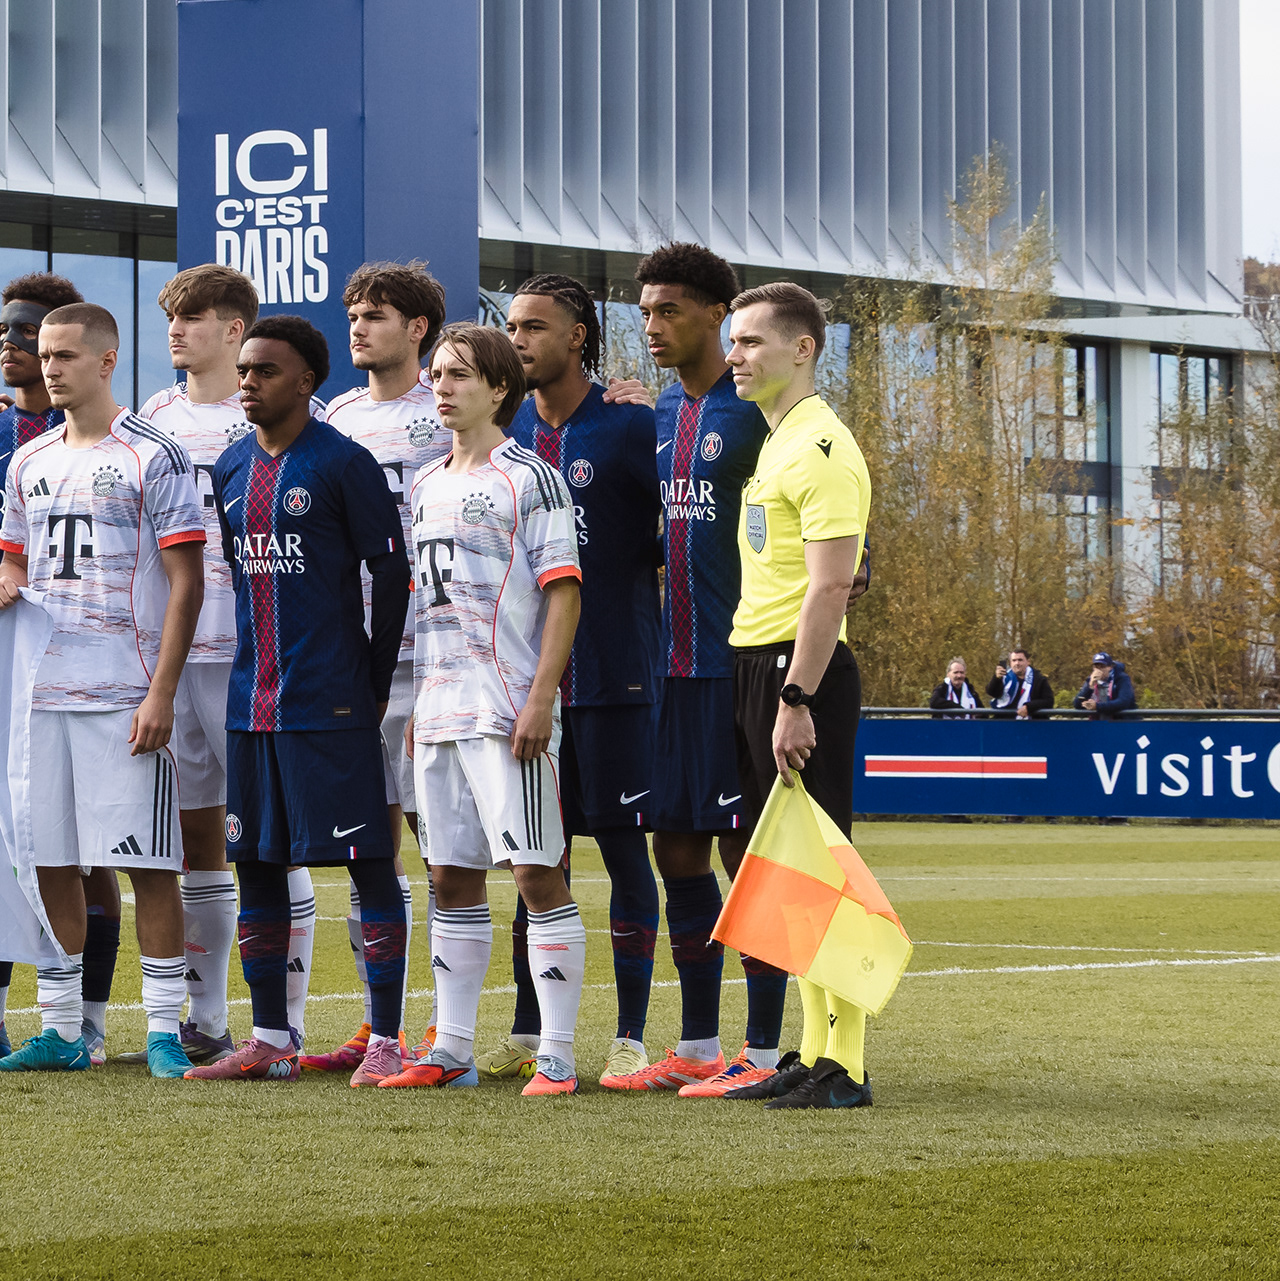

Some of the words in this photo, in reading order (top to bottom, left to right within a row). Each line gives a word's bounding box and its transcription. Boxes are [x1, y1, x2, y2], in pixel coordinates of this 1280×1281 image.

[215, 128, 328, 196] ICI
[216, 195, 328, 228] C'EST
[660, 479, 716, 509] QATAR
[666, 504, 716, 521] AIRWAYS
[233, 533, 304, 564] QATAR
[242, 559, 305, 574] AIRWAYS
